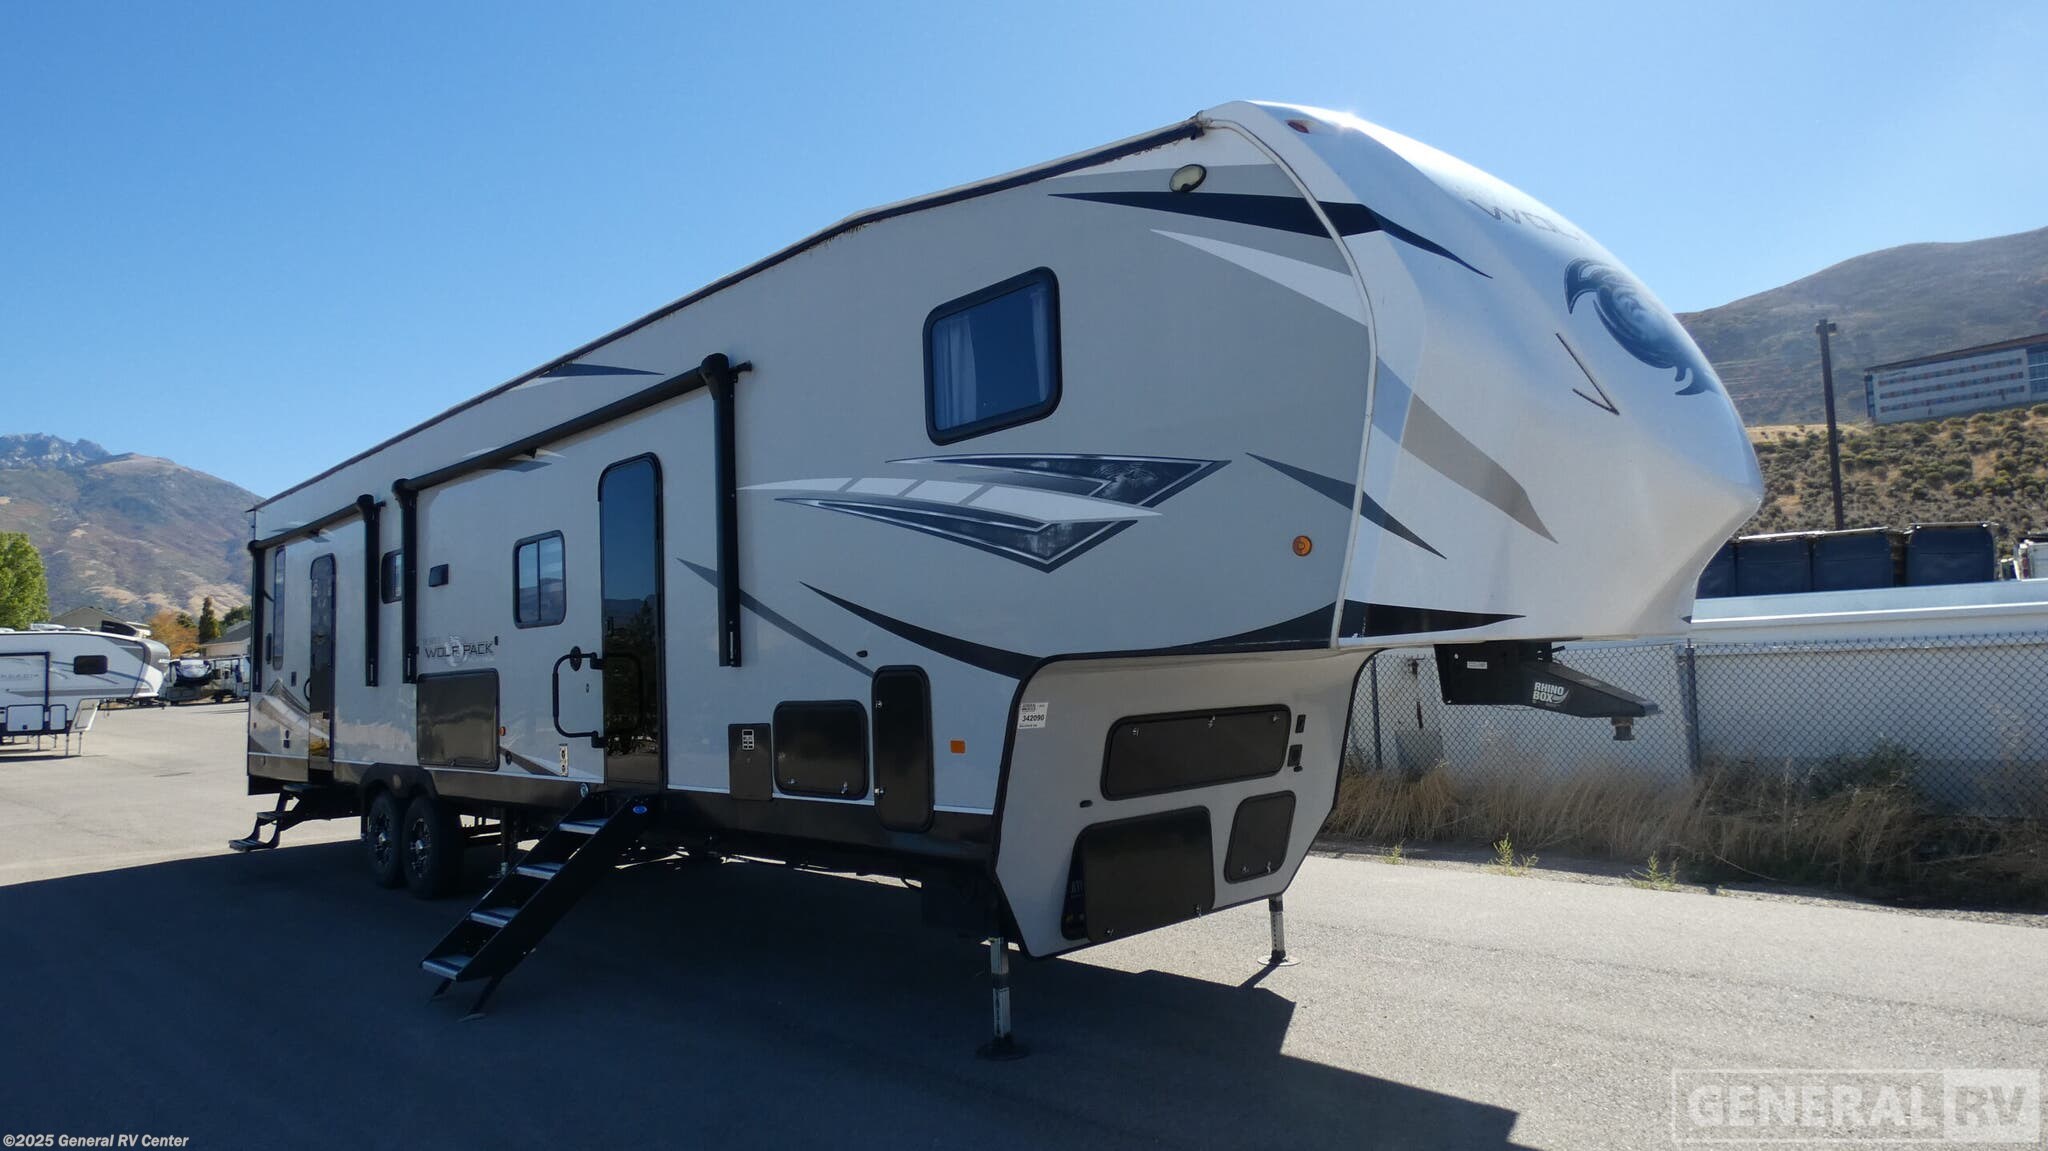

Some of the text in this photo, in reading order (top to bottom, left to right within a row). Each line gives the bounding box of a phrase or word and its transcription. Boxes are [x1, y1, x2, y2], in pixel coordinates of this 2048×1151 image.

[1467, 199, 1582, 241] WOL
[424, 642, 494, 658] WOLF PACK
[1533, 690, 1553, 703] BOX
[1534, 682, 1565, 696] RHINO
